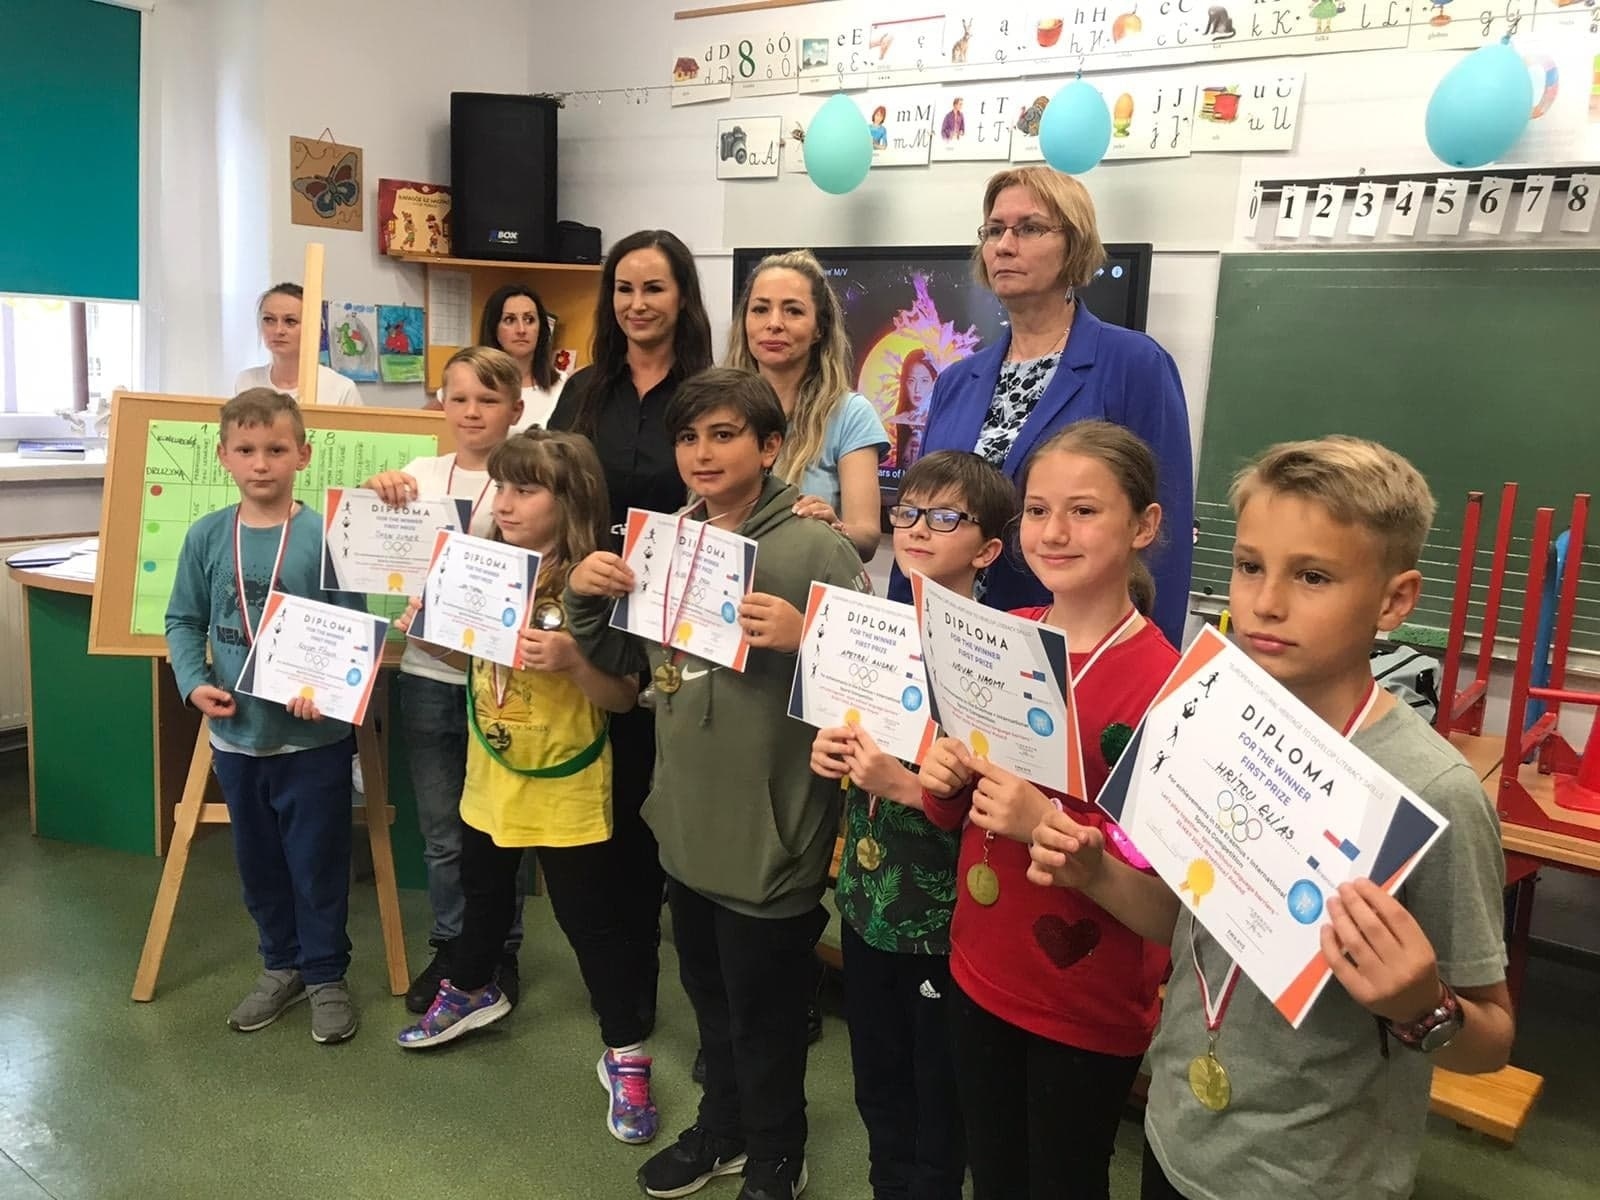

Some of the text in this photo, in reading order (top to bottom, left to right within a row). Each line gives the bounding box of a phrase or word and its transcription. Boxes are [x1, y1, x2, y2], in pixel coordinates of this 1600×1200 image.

[1074, 8, 1107, 24] h H
[1160, 2, 1170, 15] c
[1361, 1, 1398, 29] l L
[1000, 20, 1008, 36] ą
[1252, 9, 1293, 37] k K
[1480, 10, 1494, 37] g
[766, 38, 775, 55] ó
[778, 32, 791, 53] Ó
[837, 28, 863, 47] e E
[1070, 33, 1082, 54] h
[704, 44, 730, 62] d D
[766, 54, 791, 79] ó Ó
[1153, 87, 1183, 114] j J
[1254, 85, 1265, 99] u
[897, 104, 932, 123] m M
[980, 96, 1009, 115] t T
[1249, 106, 1291, 131] u U
[893, 128, 929, 149] m M
[1150, 115, 1181, 149] j J
[748, 141, 778, 166] a A
[1249, 184, 1589, 220] 0 1 2 3 4 5 6 7 8
[833, 268, 848, 276] M/V
[201, 424, 208, 433] 1
[324, 431, 336, 446] 8
[892, 468, 901, 479] of
[371, 504, 430, 516] DIPLOMA
[463, 551, 508, 570] DIPLOMA
[303, 613, 353, 633] DIPLOMA
[846, 611, 908, 637] DIPLOMA
[944, 611, 1009, 651] DIPLOMA
[849, 627, 897, 646] FOR THE WINNER
[948, 632, 1002, 661] FOR THE WINNER
[956, 647, 995, 670] FIRST PRIZE
[1239, 704, 1339, 796] DIPLOMA
[1236, 731, 1312, 802] FOR THE WINNER
[1239, 755, 1292, 806] FIRST PRIZE
[1166, 774, 1177, 784] For
[1175, 782, 1210, 818] achievements
[1208, 817, 1216, 825] in
[1214, 823, 1224, 833] the
[1209, 832, 1244, 868] Competition
